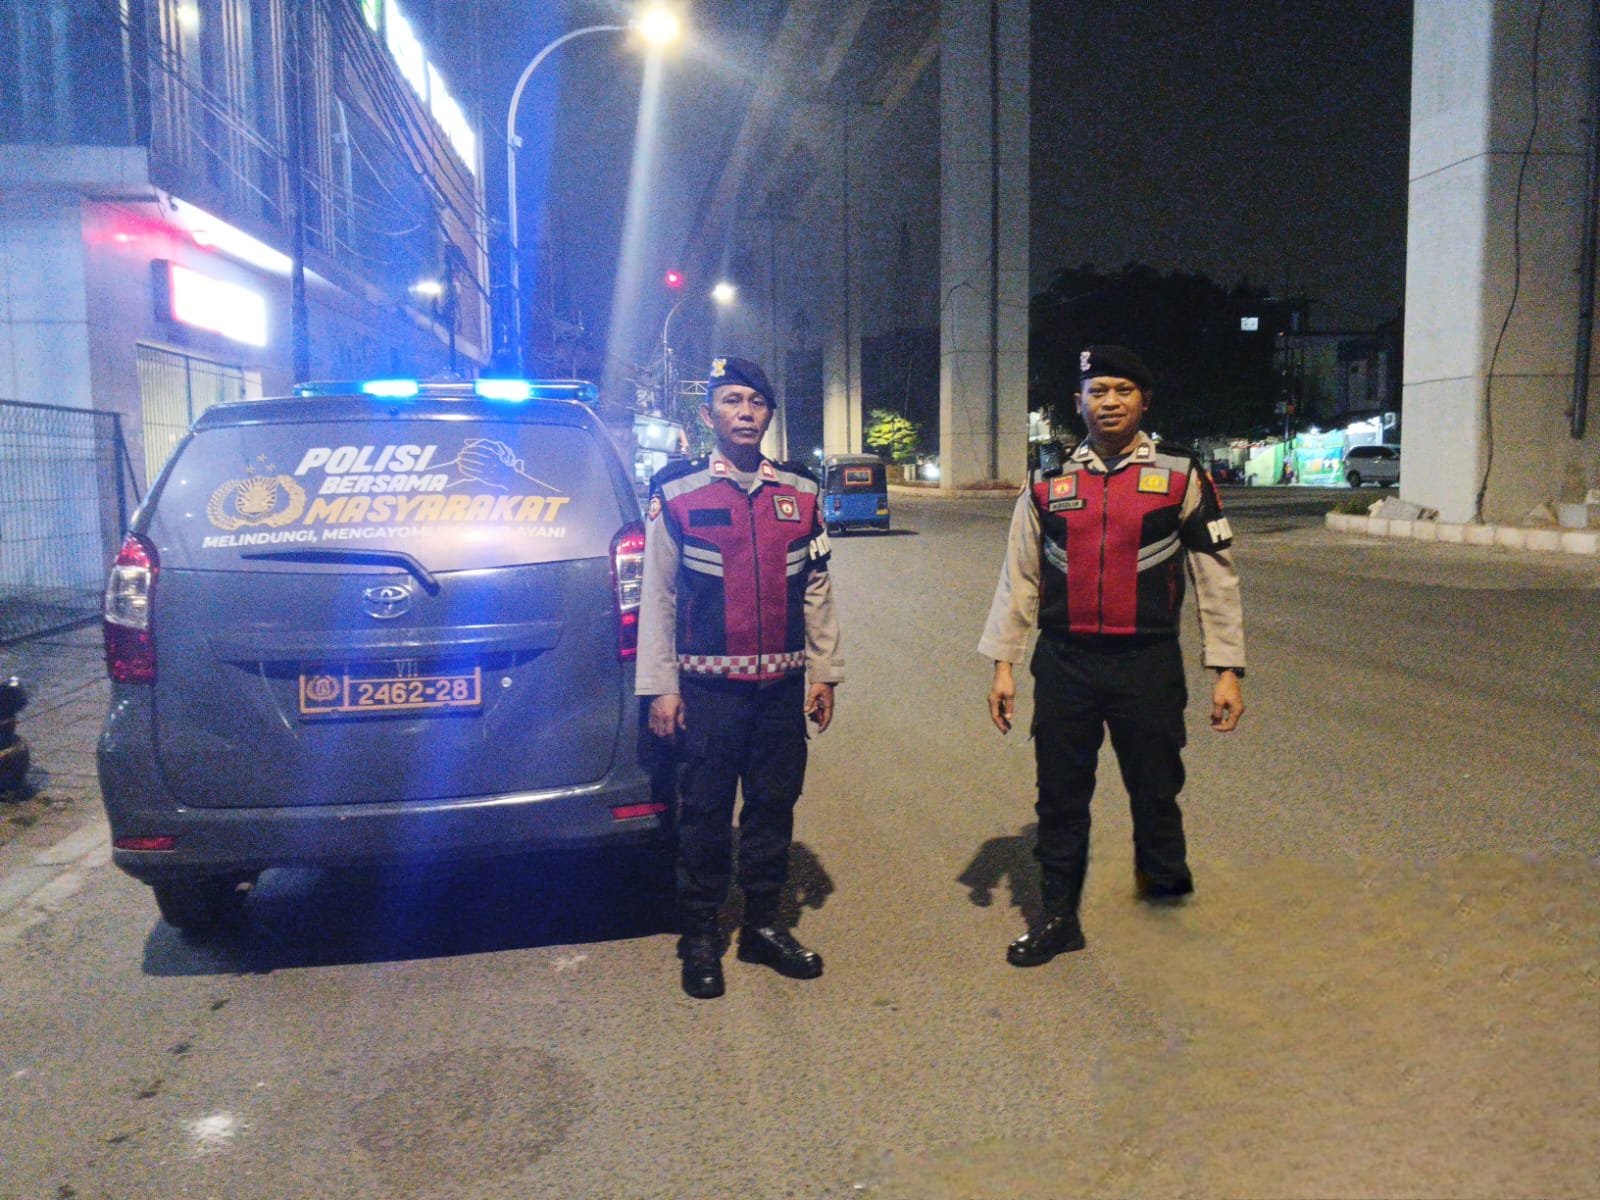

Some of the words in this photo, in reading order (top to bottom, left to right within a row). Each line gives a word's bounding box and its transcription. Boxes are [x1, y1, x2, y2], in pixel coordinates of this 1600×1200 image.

[294, 444, 438, 475] POLISI
[319, 474, 449, 495] BERSAMA
[303, 495, 570, 525] MASYARAKAT
[202, 530, 317, 549] MELINDUNGI,
[358, 679, 469, 705] 2462-28
